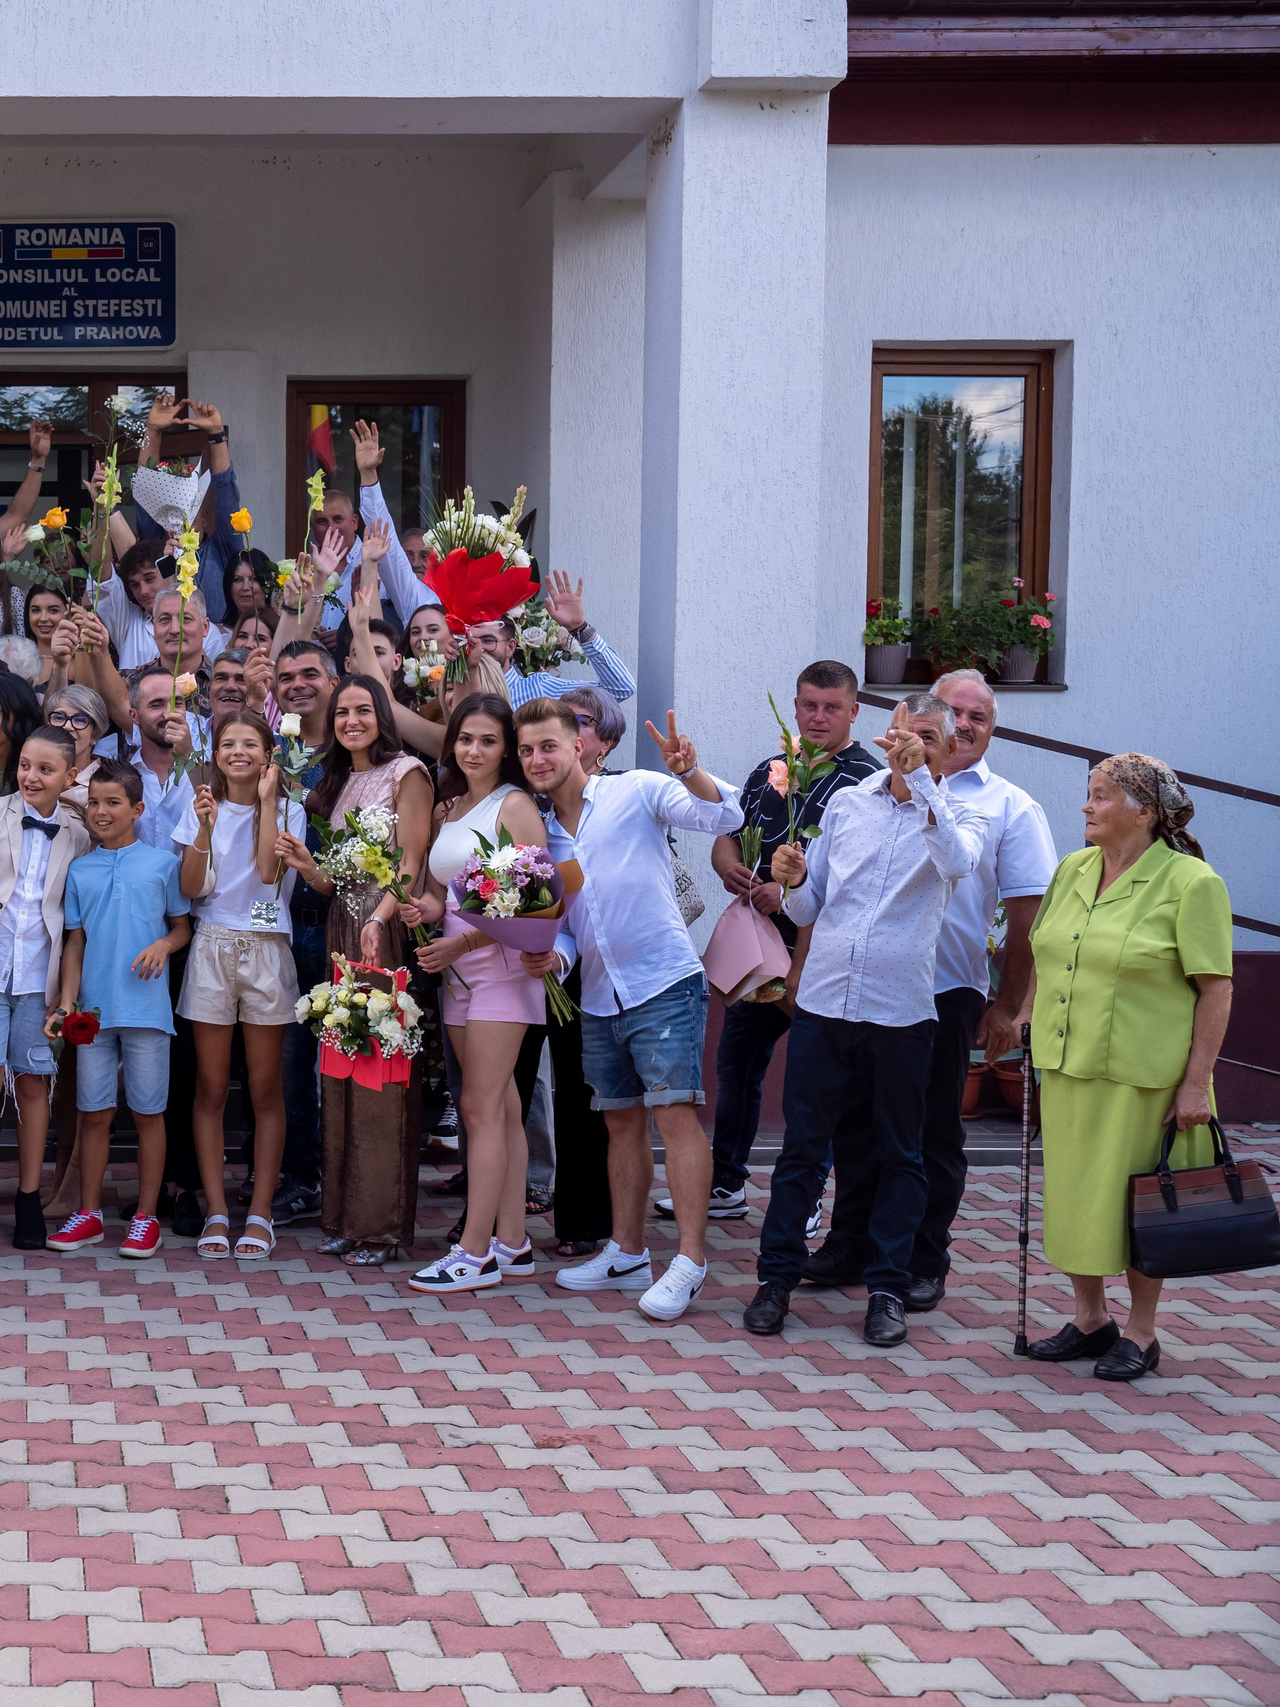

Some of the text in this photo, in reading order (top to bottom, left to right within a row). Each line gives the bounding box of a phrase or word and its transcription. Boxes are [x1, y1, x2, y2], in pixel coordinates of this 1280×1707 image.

[14, 228, 126, 246] ROMANIA
[95, 267, 161, 283] LOCAL
[62, 287, 78, 296] AL
[73, 298, 162, 318] STEFESTI
[74, 325, 162, 340] PRAHOVA
